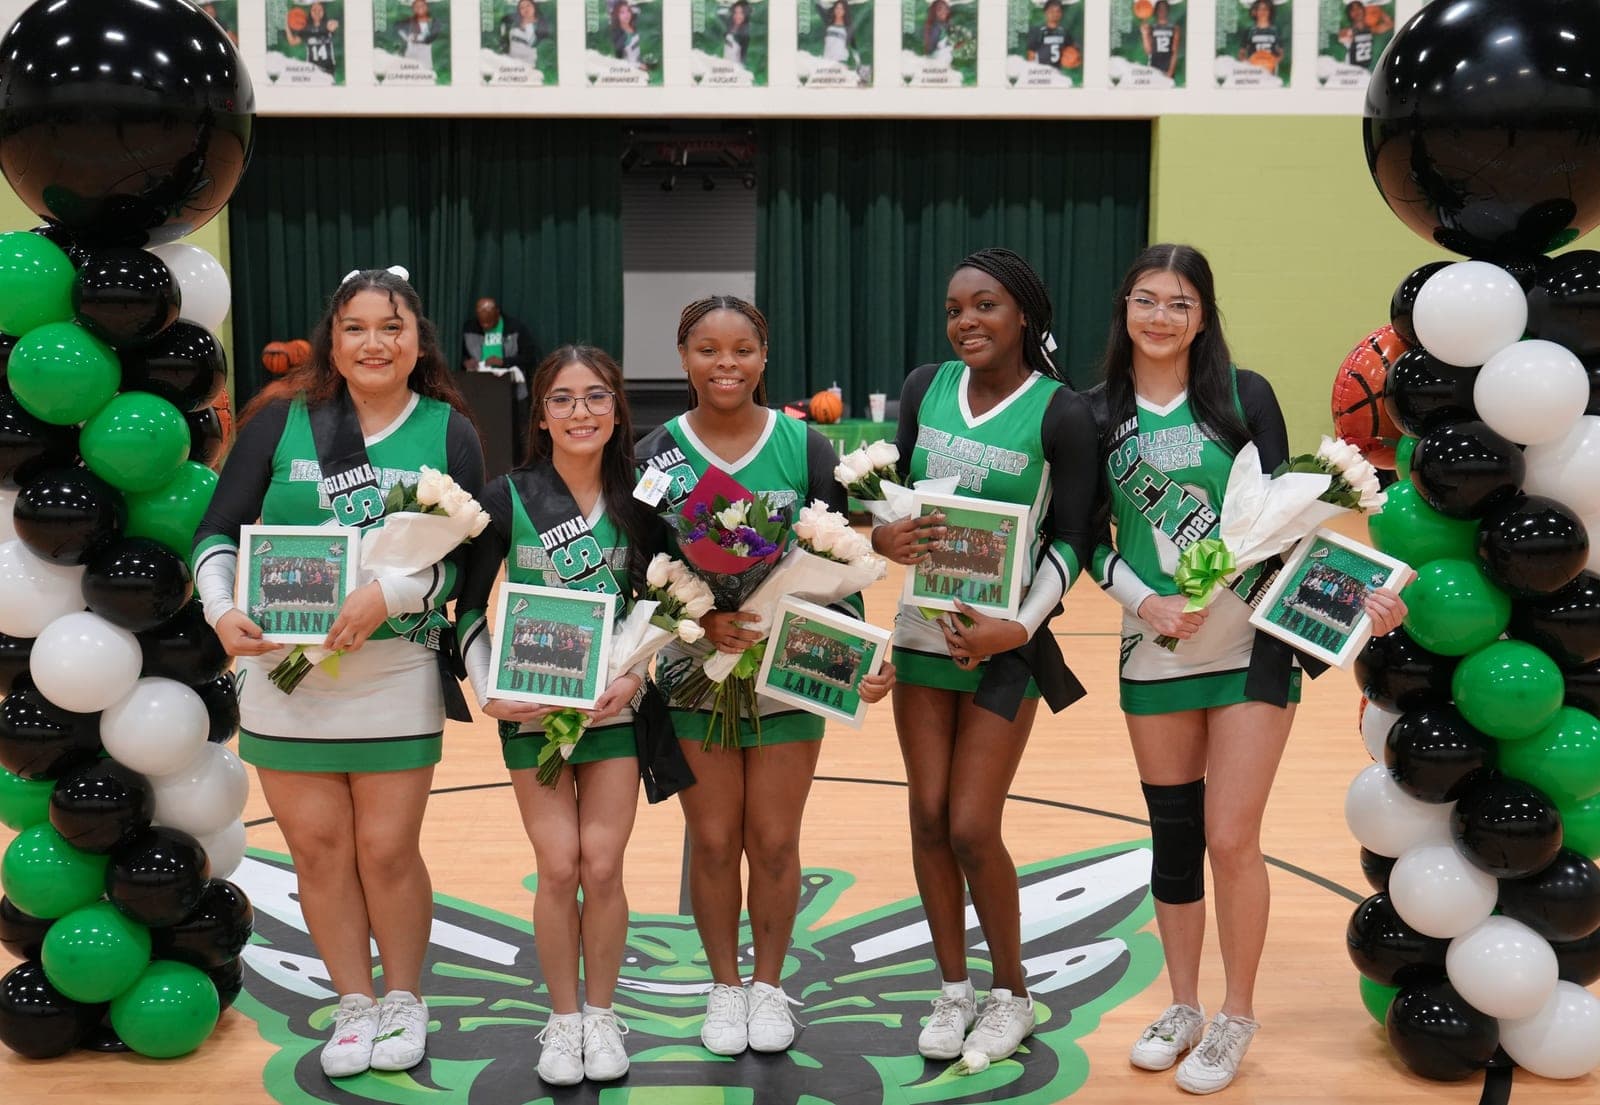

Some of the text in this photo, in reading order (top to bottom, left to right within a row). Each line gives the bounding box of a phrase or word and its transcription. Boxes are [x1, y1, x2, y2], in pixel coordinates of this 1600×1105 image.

[1050, 44, 1061, 63] 5
[639, 447, 686, 472] AMIA
[981, 445, 1029, 476] PREP
[324, 463, 376, 495] GIANNA
[539, 515, 591, 549] DIVINA
[1174, 506, 1218, 550] 2026
[924, 574, 1003, 605] MARIAM
[509, 672, 585, 698] DIVINA
[782, 672, 845, 708] LAMIA
